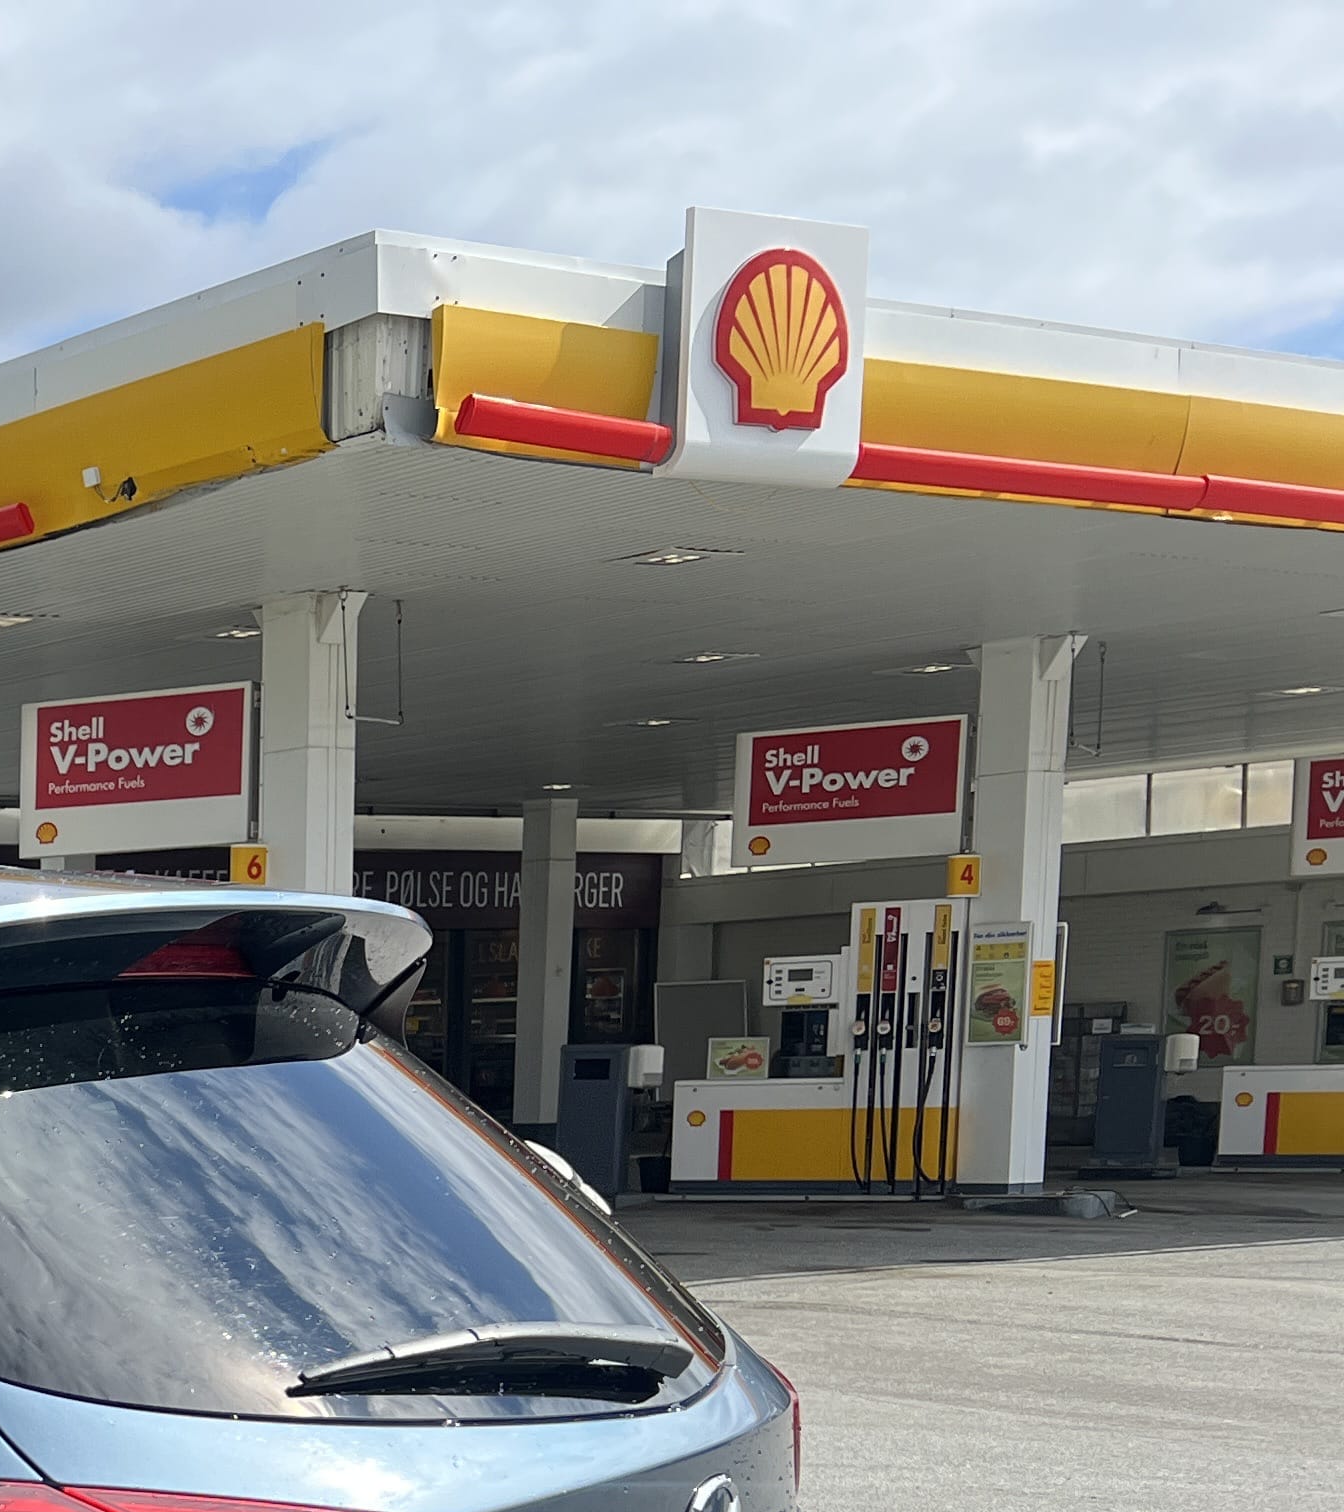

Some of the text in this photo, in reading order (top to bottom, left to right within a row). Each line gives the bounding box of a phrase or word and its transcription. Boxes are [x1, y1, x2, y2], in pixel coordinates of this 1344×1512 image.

[49, 716, 104, 743] Shell
[50, 741, 201, 775] V-Power
[764, 745, 820, 768] Shell
[48, 775, 145, 795] Performance Fuels
[765, 766, 915, 796] V-Power
[762, 795, 860, 814] Performance Fuels
[247, 855, 262, 880] 6
[960, 864, 974, 885] 4
[385, 869, 454, 908] PØLSE
[459, 871, 489, 908] OG
